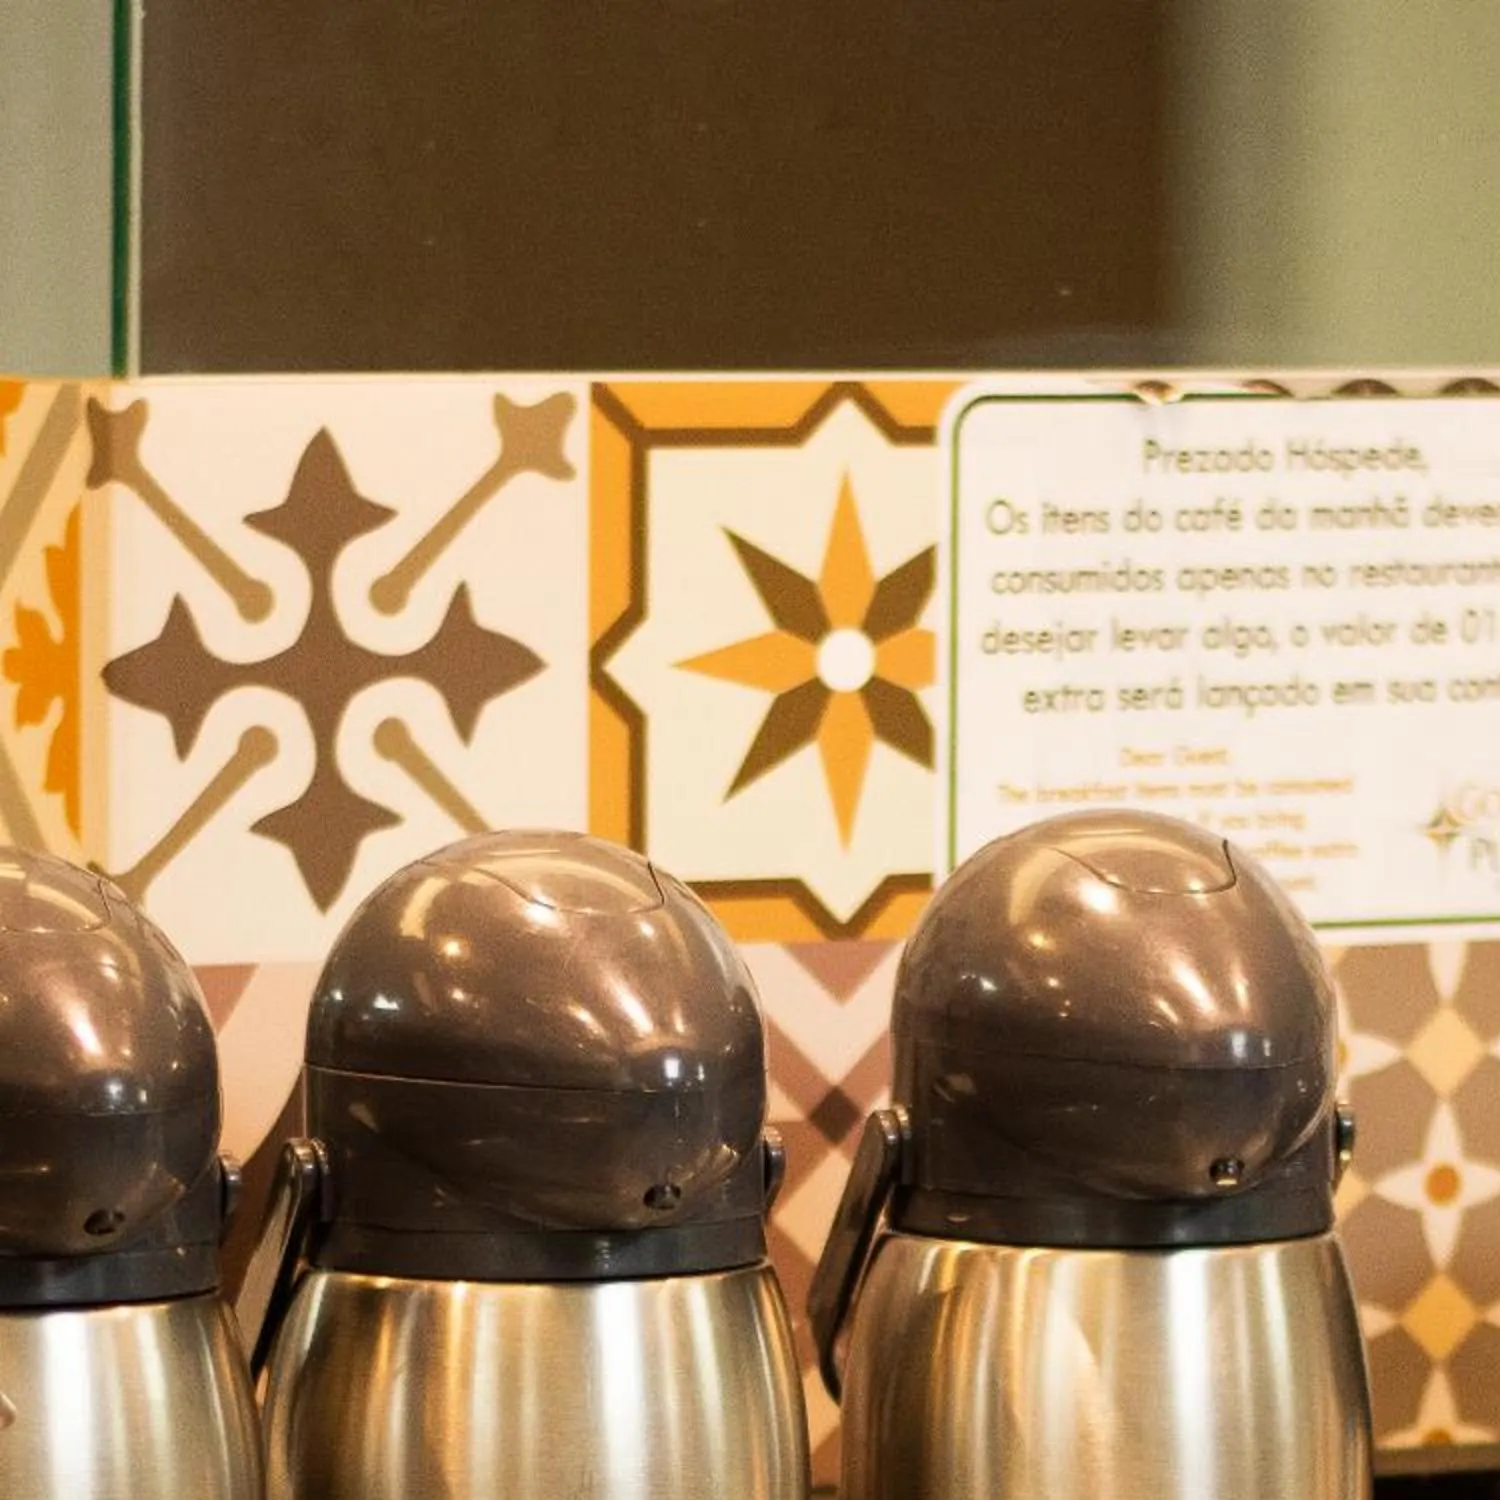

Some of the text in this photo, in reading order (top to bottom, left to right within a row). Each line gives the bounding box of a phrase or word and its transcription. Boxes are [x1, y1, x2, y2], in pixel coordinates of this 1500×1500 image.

[1143, 437, 1427, 479] Prezado Hóspede,
[986, 499, 1029, 534] Os
[1042, 502, 1111, 533] itens
[1175, 498, 1243, 531] café
[1309, 496, 1410, 529] manhã
[991, 557, 1164, 594] consumidos
[1176, 566, 1290, 600] apenas
[1301, 564, 1337, 588] no
[980, 620, 1099, 661] desejar
[1110, 617, 1189, 651] levar
[1201, 616, 1279, 659] algo,
[1289, 623, 1310, 648] o
[1320, 612, 1398, 647] valor
[1410, 610, 1448, 645] de
[1459, 607, 1497, 644] 01
[1022, 684, 1105, 713] extra
[1118, 676, 1184, 711] será
[1196, 674, 1319, 719] lançado
[1332, 681, 1375, 705] em
[1387, 679, 1437, 704] sua
